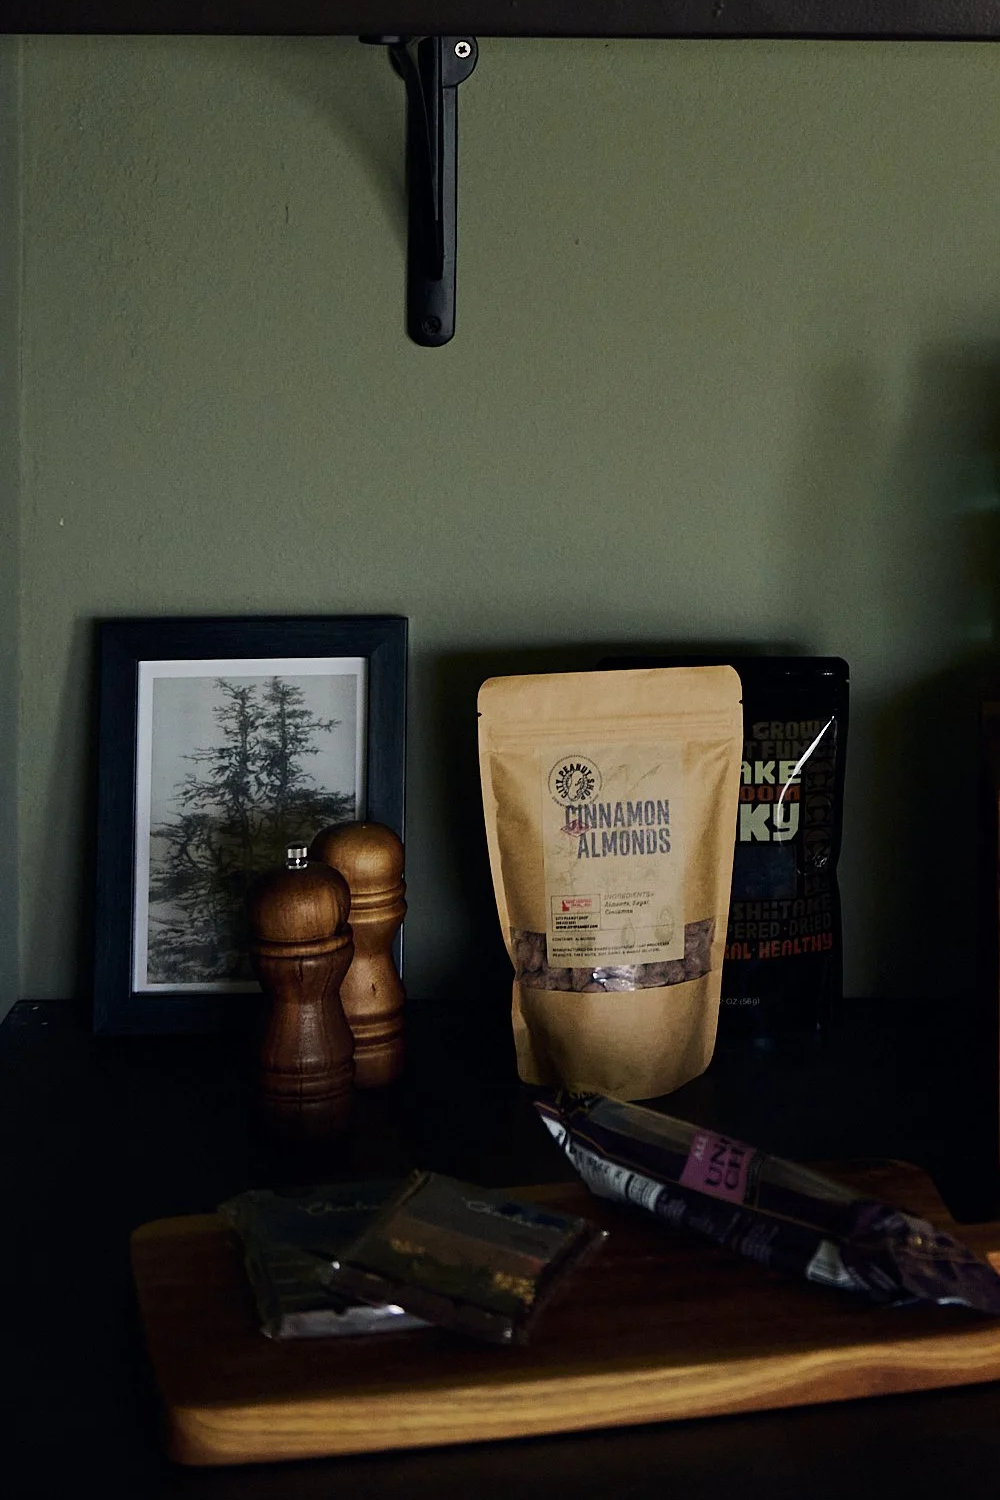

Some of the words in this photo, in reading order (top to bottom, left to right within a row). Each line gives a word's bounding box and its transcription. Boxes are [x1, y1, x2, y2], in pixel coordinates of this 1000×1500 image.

[559, 763, 592, 777] PEANUT
[565, 799, 670, 831] CINNAMON
[577, 828, 671, 859] ALMONDS
[758, 933, 833, 959] HEALTHY
